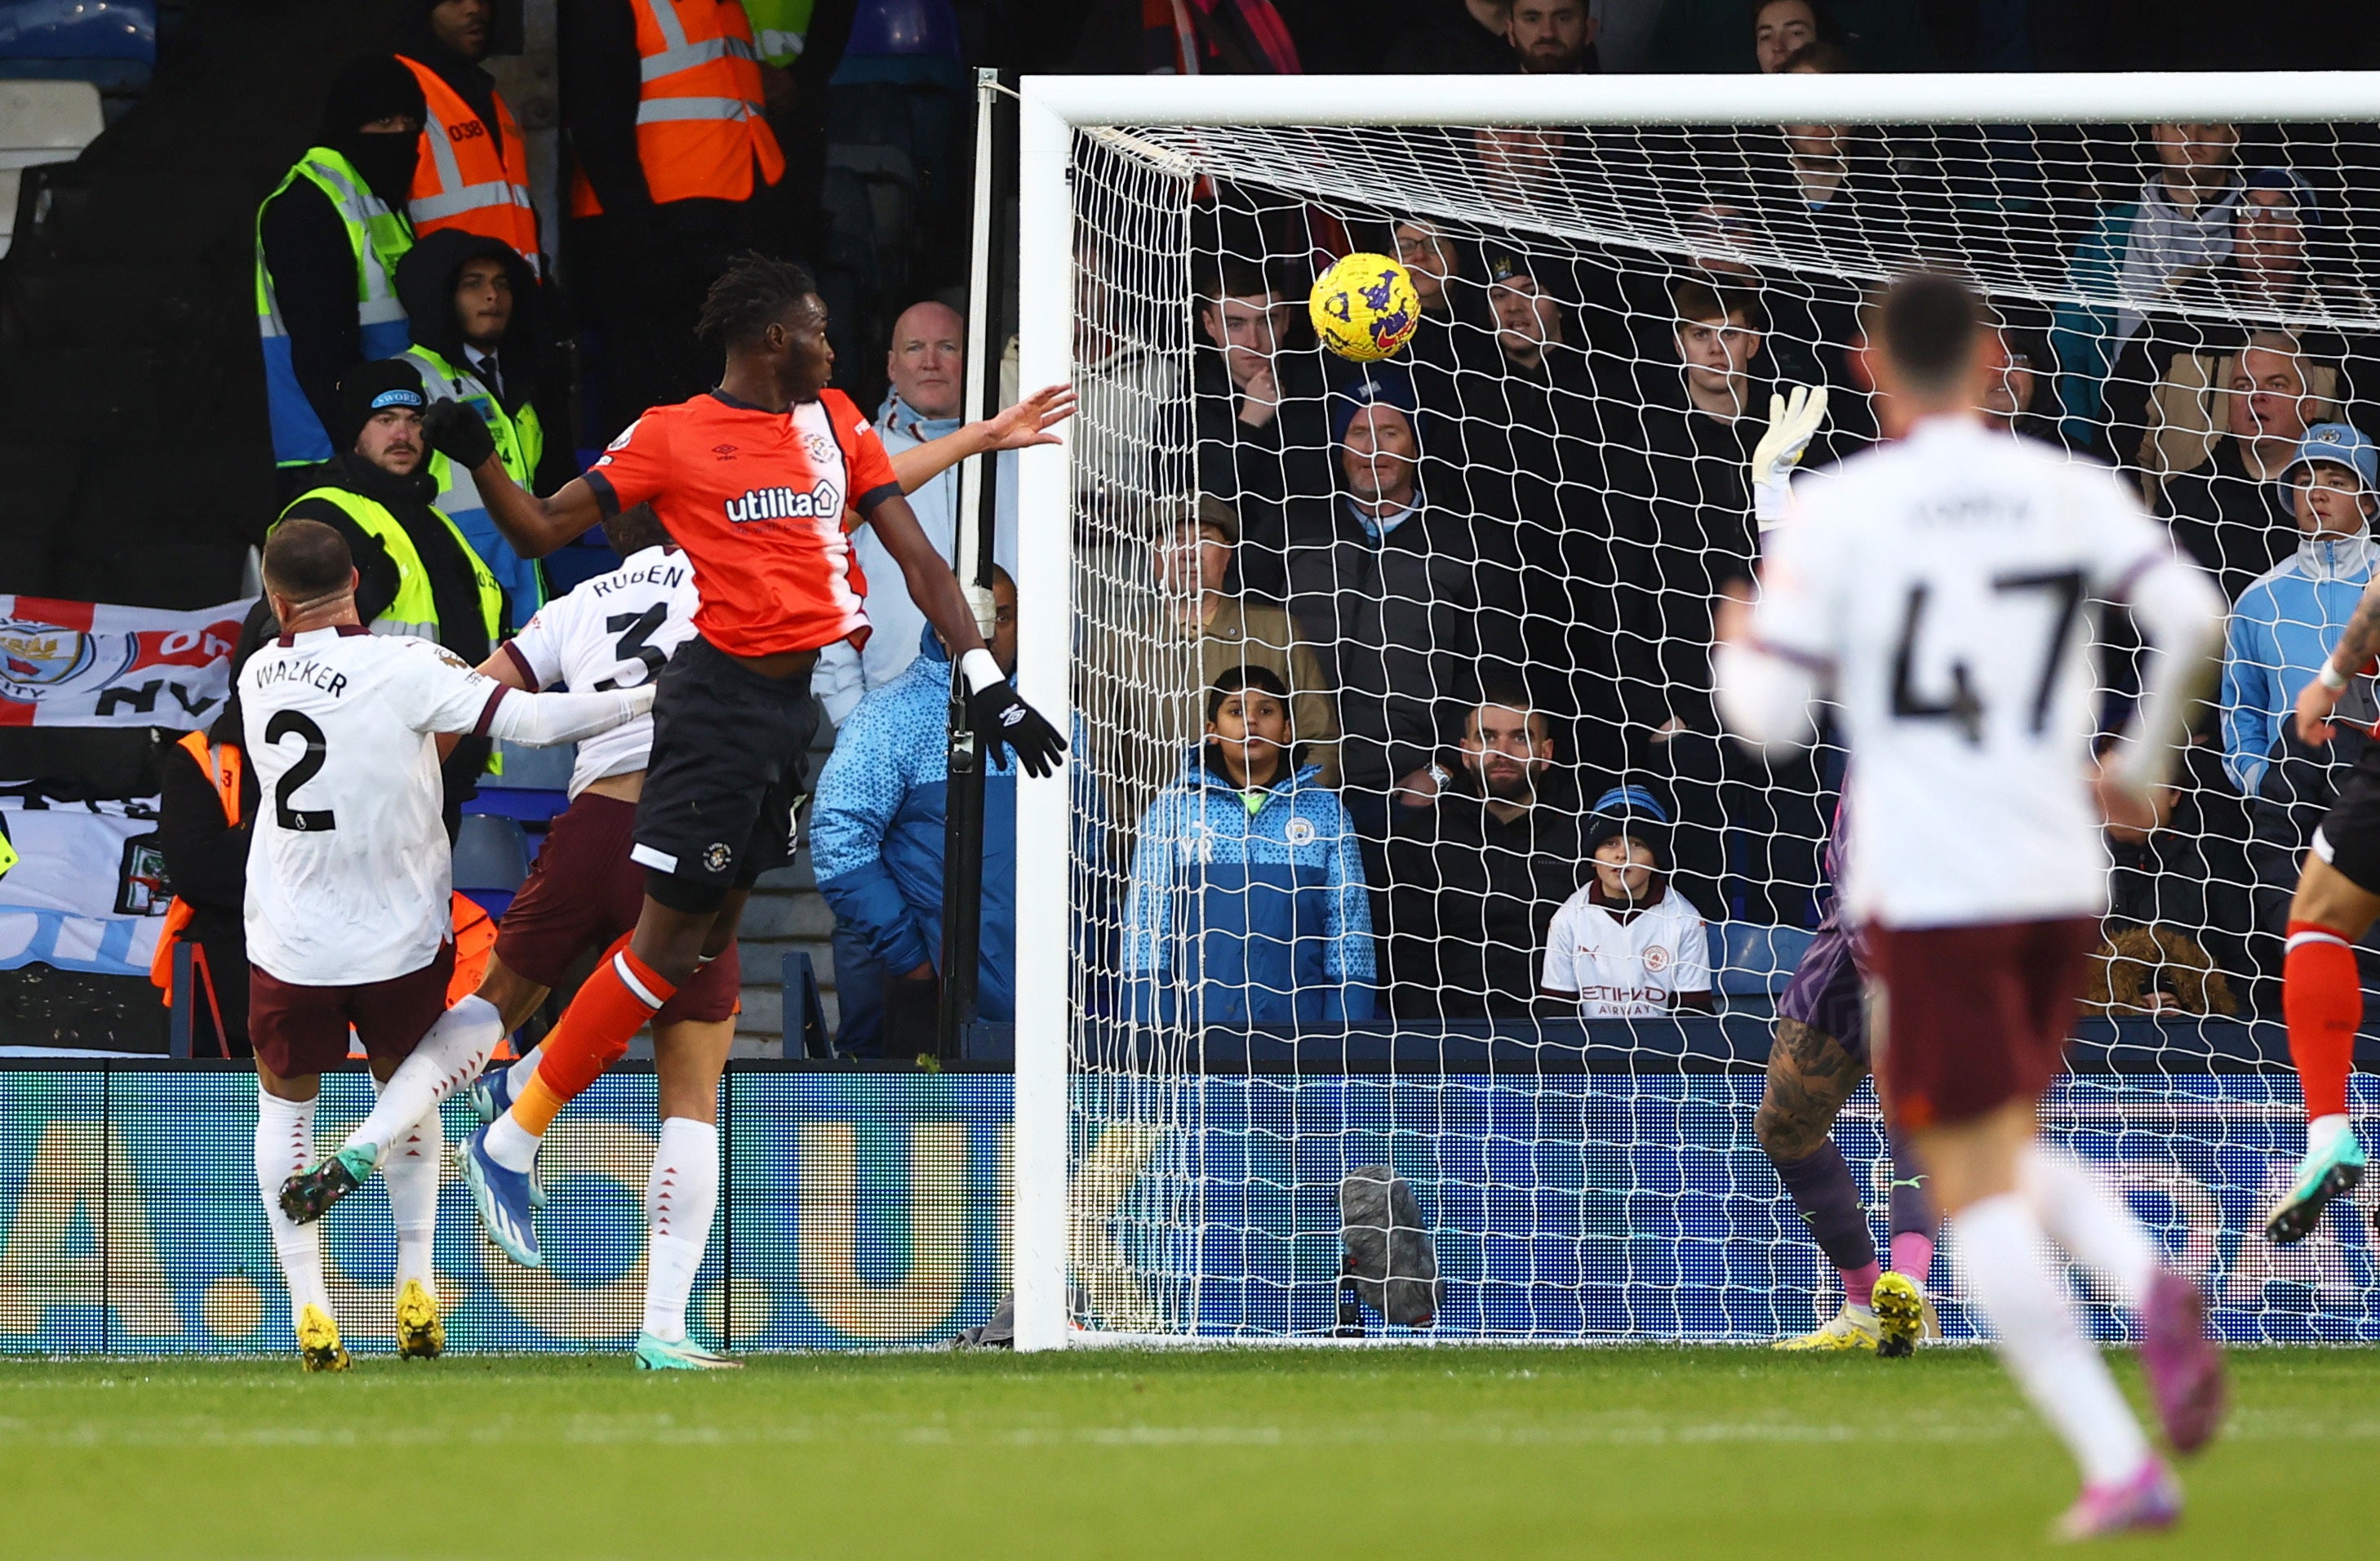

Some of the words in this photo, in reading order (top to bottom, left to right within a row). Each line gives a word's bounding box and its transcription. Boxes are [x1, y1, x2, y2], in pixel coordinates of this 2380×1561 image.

[449, 119, 485, 143] 038
[377, 393, 418, 406] SWORD
[725, 487, 814, 523] utilita
[593, 601, 668, 692] 3
[1889, 567, 2089, 749] 47
[255, 659, 348, 699] WALKER
[264, 709, 336, 832] 2
